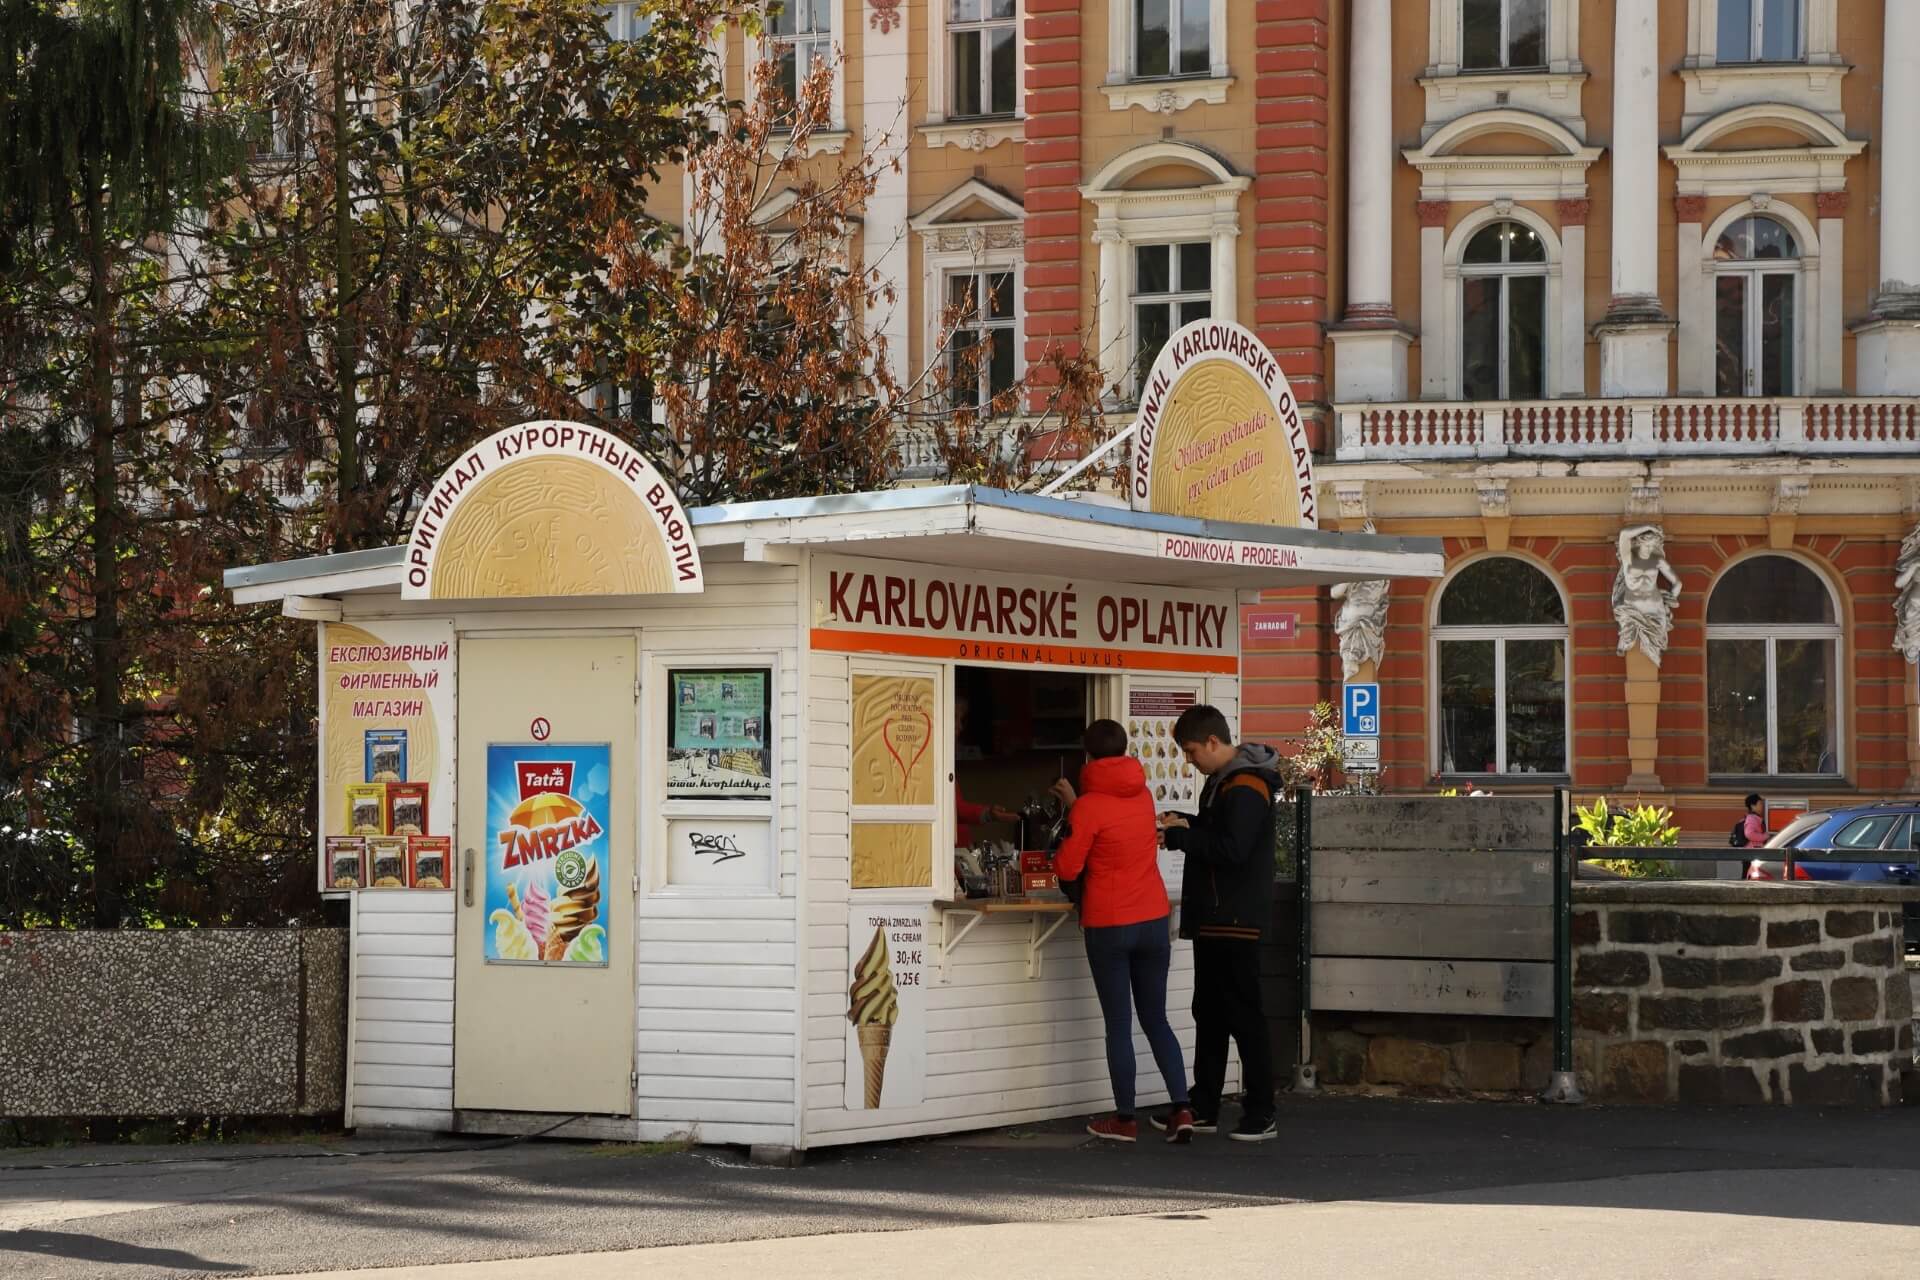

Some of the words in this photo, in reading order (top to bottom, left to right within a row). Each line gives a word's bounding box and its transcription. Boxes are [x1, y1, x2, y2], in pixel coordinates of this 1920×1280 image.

[1172, 325, 1278, 391] KARLOVARSKÉ
[1279, 392, 1315, 523] OPLATKY
[408, 452, 486, 588] ОРИГИНАЛ
[495, 426, 645, 483] КУРОРТНЫЕ
[646, 483, 698, 582] ВАФЛИ
[1165, 538, 1235, 563] PODNIKOVÁ
[1241, 546, 1298, 567] PRODEJNA
[829, 570, 1078, 640] KARLOVARSKÉ
[1098, 594, 1228, 649] OPLATKY
[330, 641, 449, 662] ЕКСЛЮЗИВНЫЙ
[1069, 651, 1123, 666] LUXUS
[340, 668, 438, 689] ФИРМЕННЫЙ
[353, 700, 423, 717] МАГАЗИН
[1352, 688, 1371, 718] P
[525, 772, 564, 787] Tatra
[500, 814, 602, 870] ZMRZKA
[892, 917, 922, 928] ZMRZLINA
